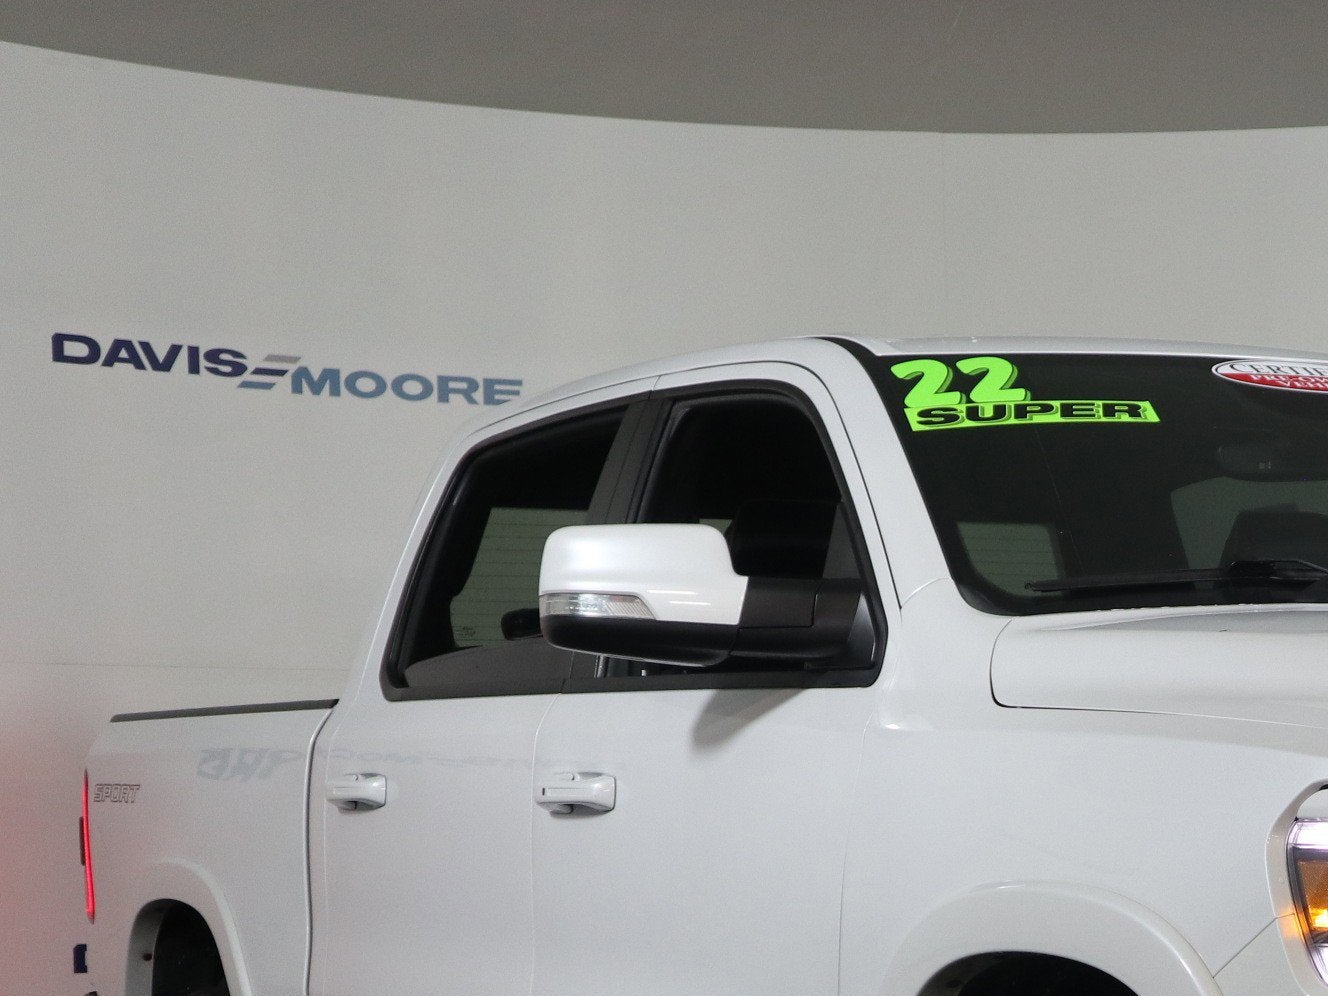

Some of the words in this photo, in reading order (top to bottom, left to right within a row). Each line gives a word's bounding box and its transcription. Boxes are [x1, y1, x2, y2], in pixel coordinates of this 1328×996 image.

[51, 332, 246, 378] DAVIS
[290, 366, 524, 405] MOORE
[890, 356, 1031, 407] 22
[916, 402, 1147, 426] SUPER
[93, 783, 141, 803] SPORT
